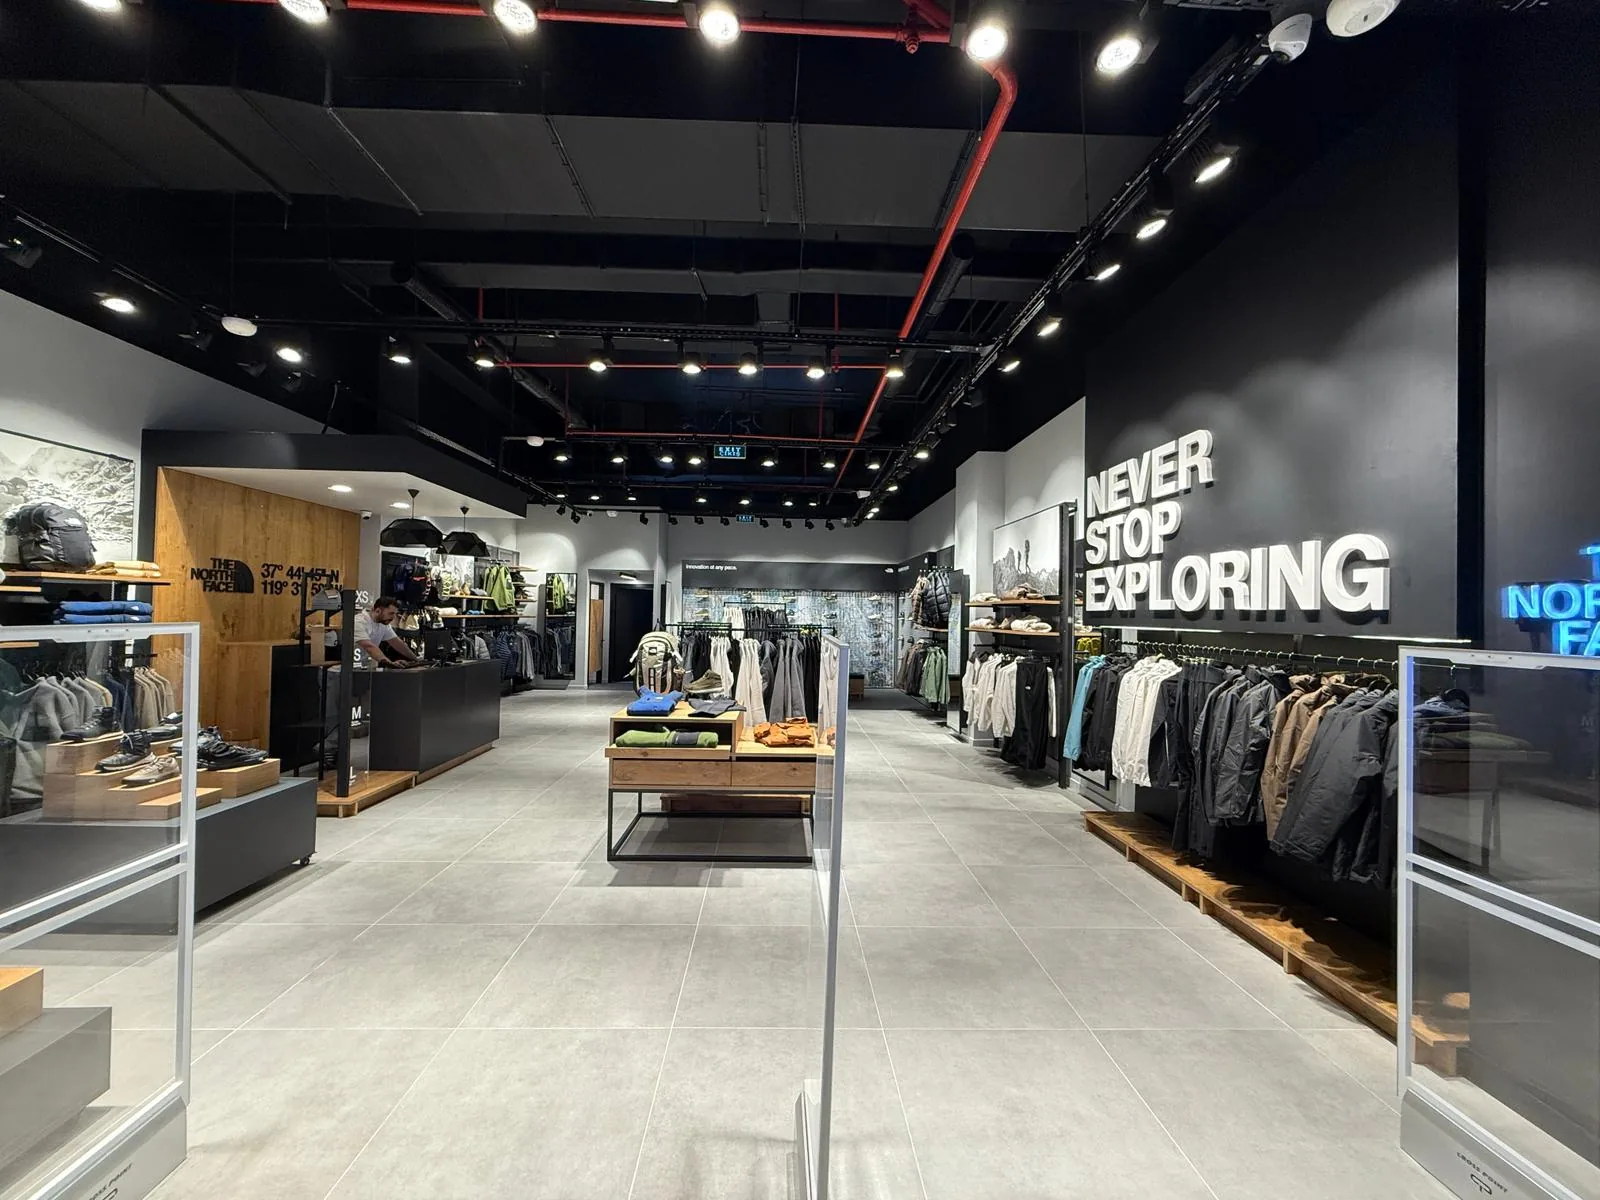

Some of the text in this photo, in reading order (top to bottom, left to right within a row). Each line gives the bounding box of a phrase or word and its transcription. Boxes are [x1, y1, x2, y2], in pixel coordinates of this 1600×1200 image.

[1087, 429, 1213, 518] NEVER
[1086, 501, 1182, 565] STOP
[210, 557, 235, 569] THE
[190, 568, 235, 581] NORTH
[1086, 533, 1390, 612] EXPLORING
[202, 581, 235, 592] FACE
[355, 590, 369, 604] XS
[353, 648, 361, 661] S
[351, 706, 362, 720] M
